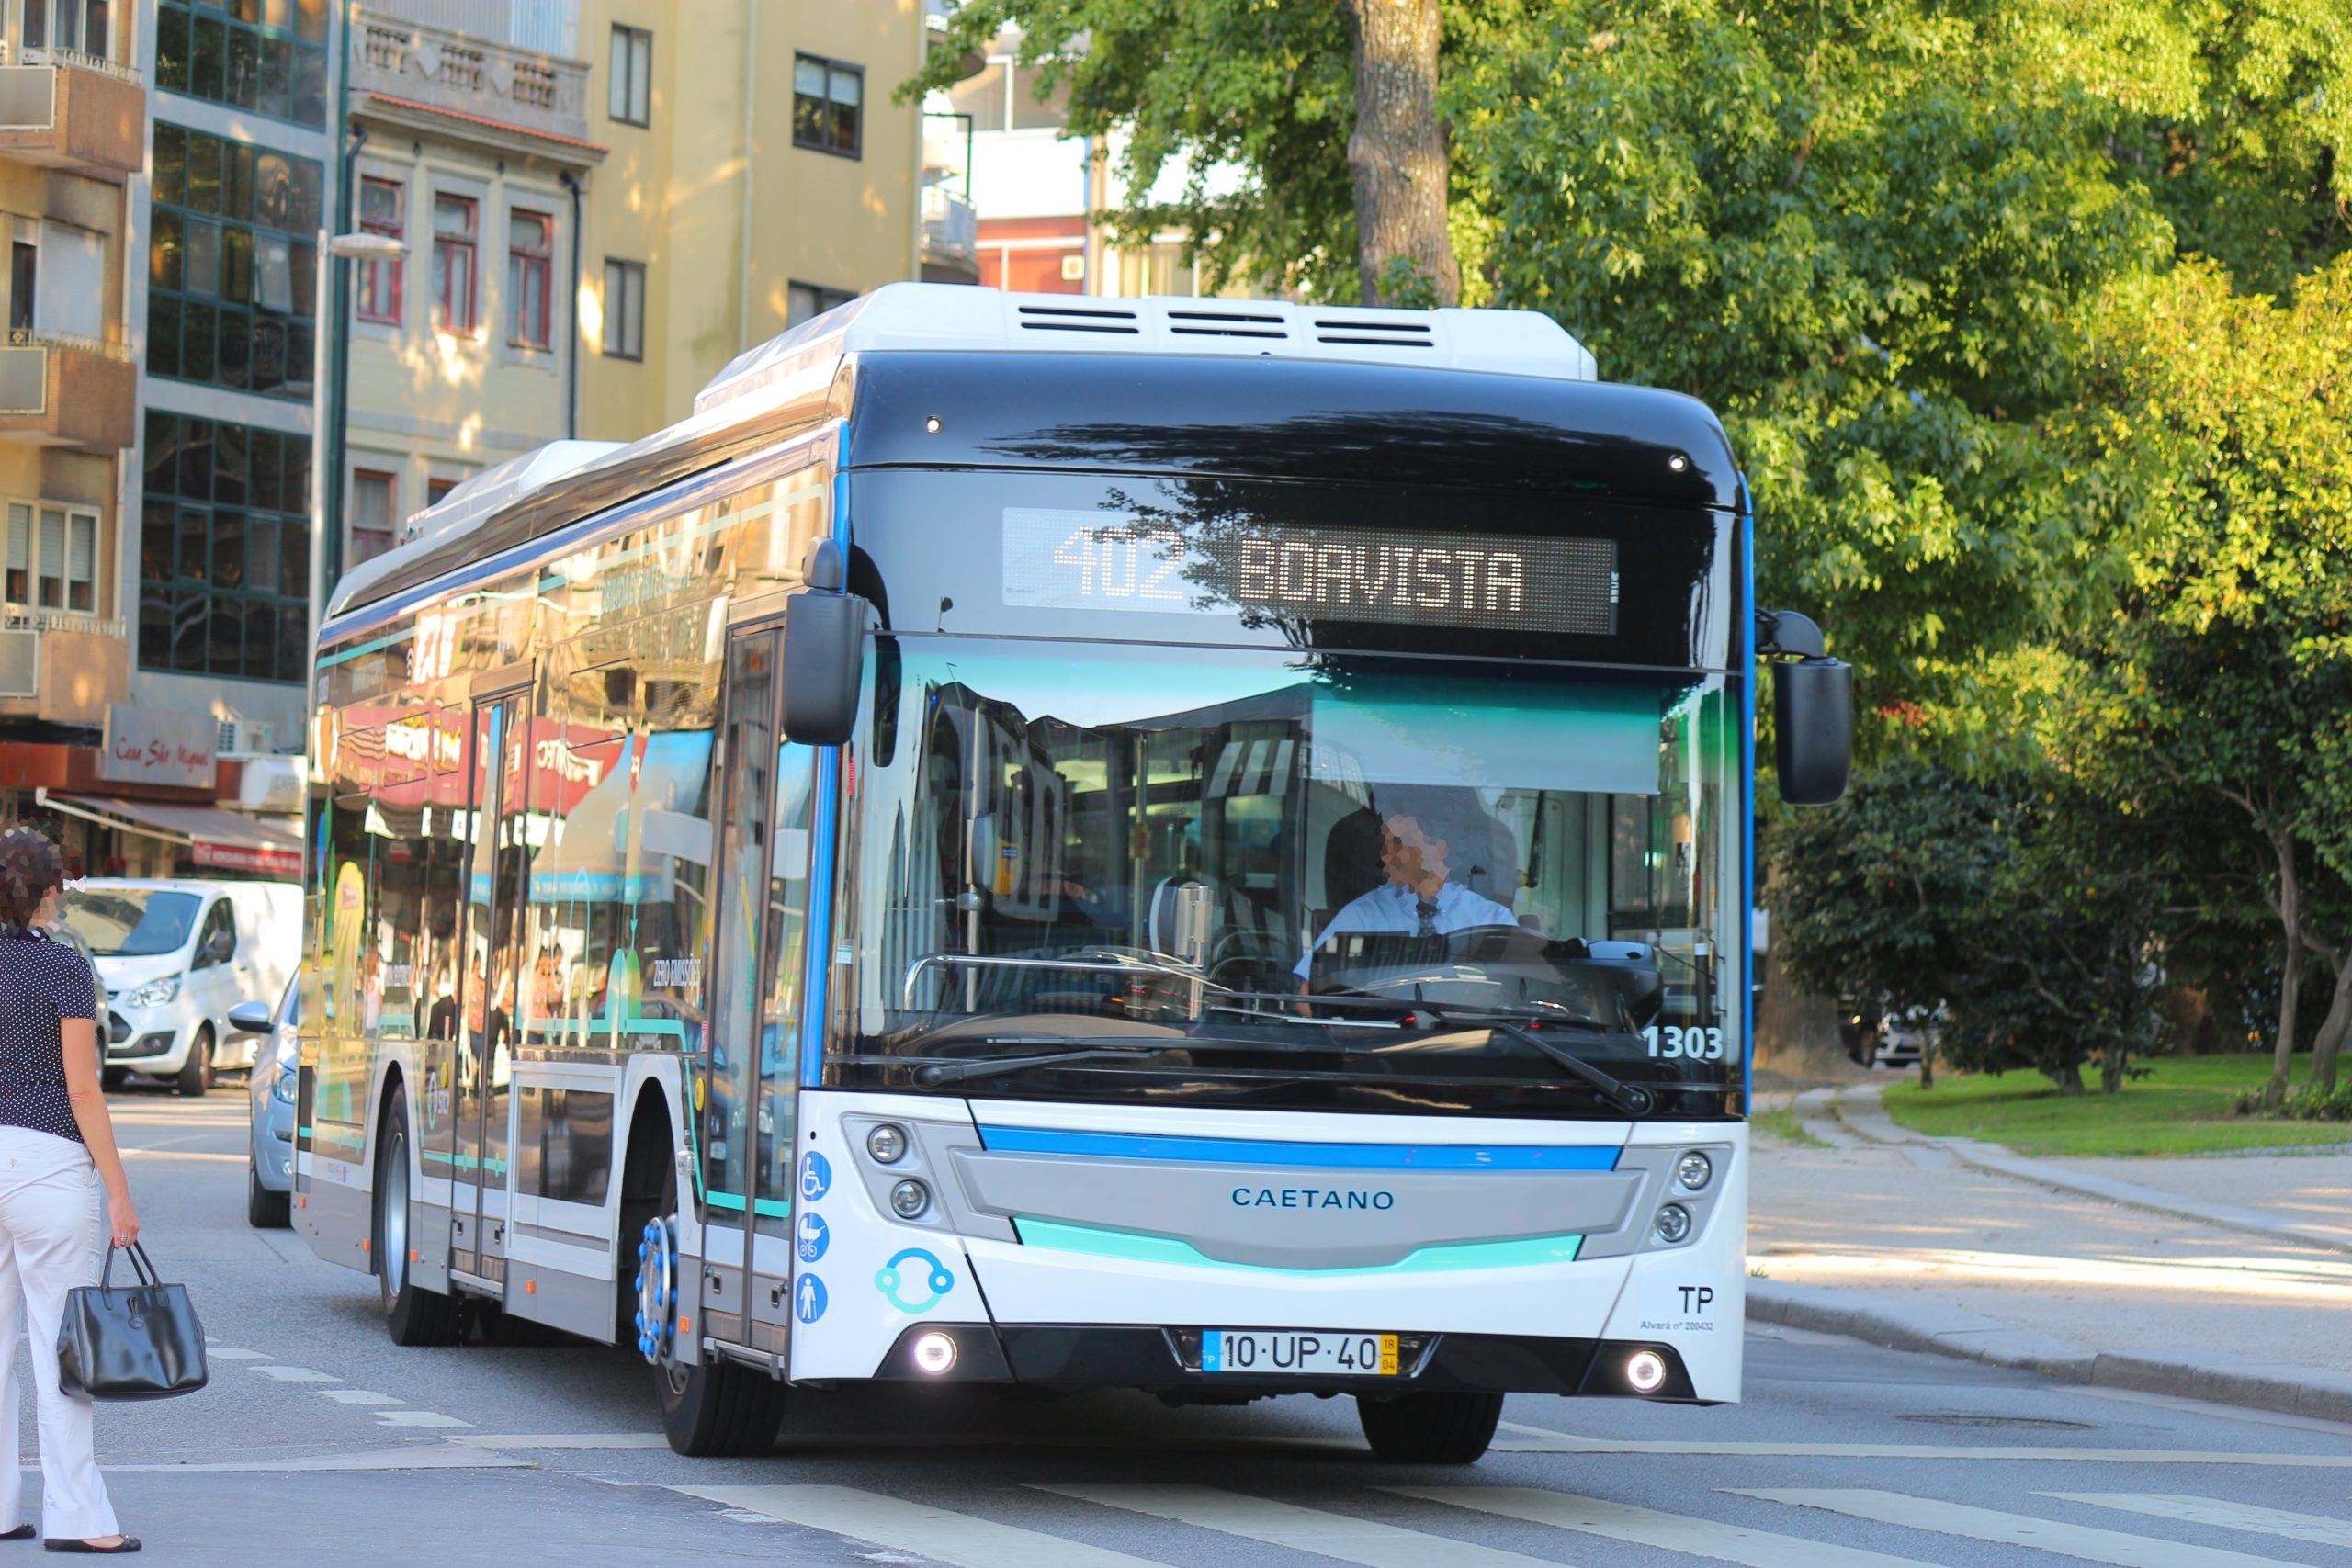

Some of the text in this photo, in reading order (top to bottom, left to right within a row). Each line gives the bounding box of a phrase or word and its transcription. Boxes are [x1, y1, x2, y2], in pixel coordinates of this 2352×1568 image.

[1054, 526, 1522, 612] 402 BOAVISTA
[1641, 1025, 1723, 1059] 1303
[1232, 1188, 1394, 1210] CAETANO
[1678, 1286, 1713, 1314] TP
[1640, 1320, 1671, 1331] Alvará
[1385, 1339, 1394, 1349] 18
[1382, 1358, 1395, 1370] 04
